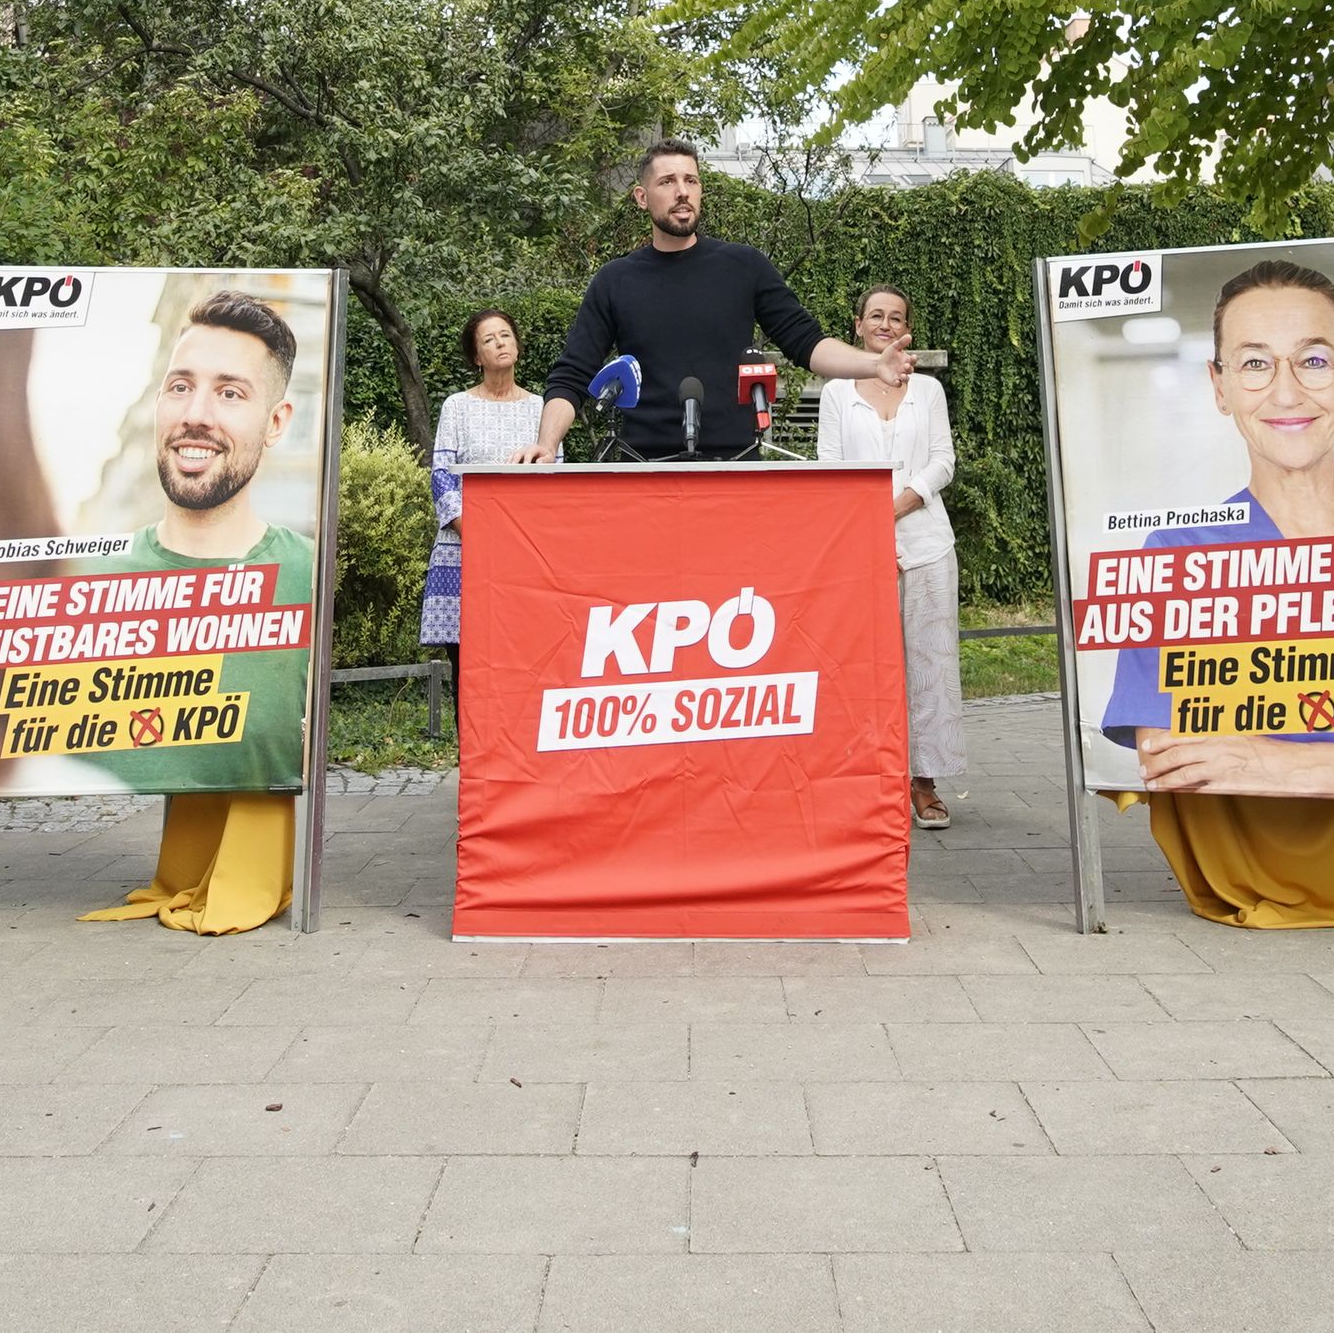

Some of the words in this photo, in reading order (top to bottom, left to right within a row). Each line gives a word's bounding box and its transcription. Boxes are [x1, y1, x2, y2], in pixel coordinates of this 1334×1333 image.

[1059, 260, 1152, 298] KPÖ
[11, 309, 28, 318] sich
[49, 310, 79, 318] ändert.
[1059, 300, 1082, 309] Damit
[1085, 299, 1103, 308] sich
[1105, 299, 1121, 307] was
[1123, 296, 1153, 305] ändert.
[741, 366, 773, 374] ORF
[1108, 512, 1161, 530] Bettina
[1166, 506, 1245, 526] Prochaska
[44, 537, 130, 556] Schweiger
[1096, 553, 1174, 596] EINE
[1183, 543, 1332, 592] STIMME
[65, 574, 196, 616] STIMME
[201, 564, 264, 607] FÜR
[166, 609, 304, 653] WOHNEN
[581, 586, 776, 678] KPÖ
[1078, 601, 1154, 644] AUS
[1163, 596, 1239, 640] DER
[4, 673, 80, 709] Eine
[88, 666, 215, 702] Stimme
[1165, 651, 1239, 687] Eine
[10, 718, 59, 754] für
[67, 713, 118, 749] die
[172, 695, 241, 741] KPÖ
[555, 693, 657, 739] 100%
[671, 683, 802, 732] SOZIAL
[1178, 697, 1225, 733] für
[1235, 695, 1286, 731] die
